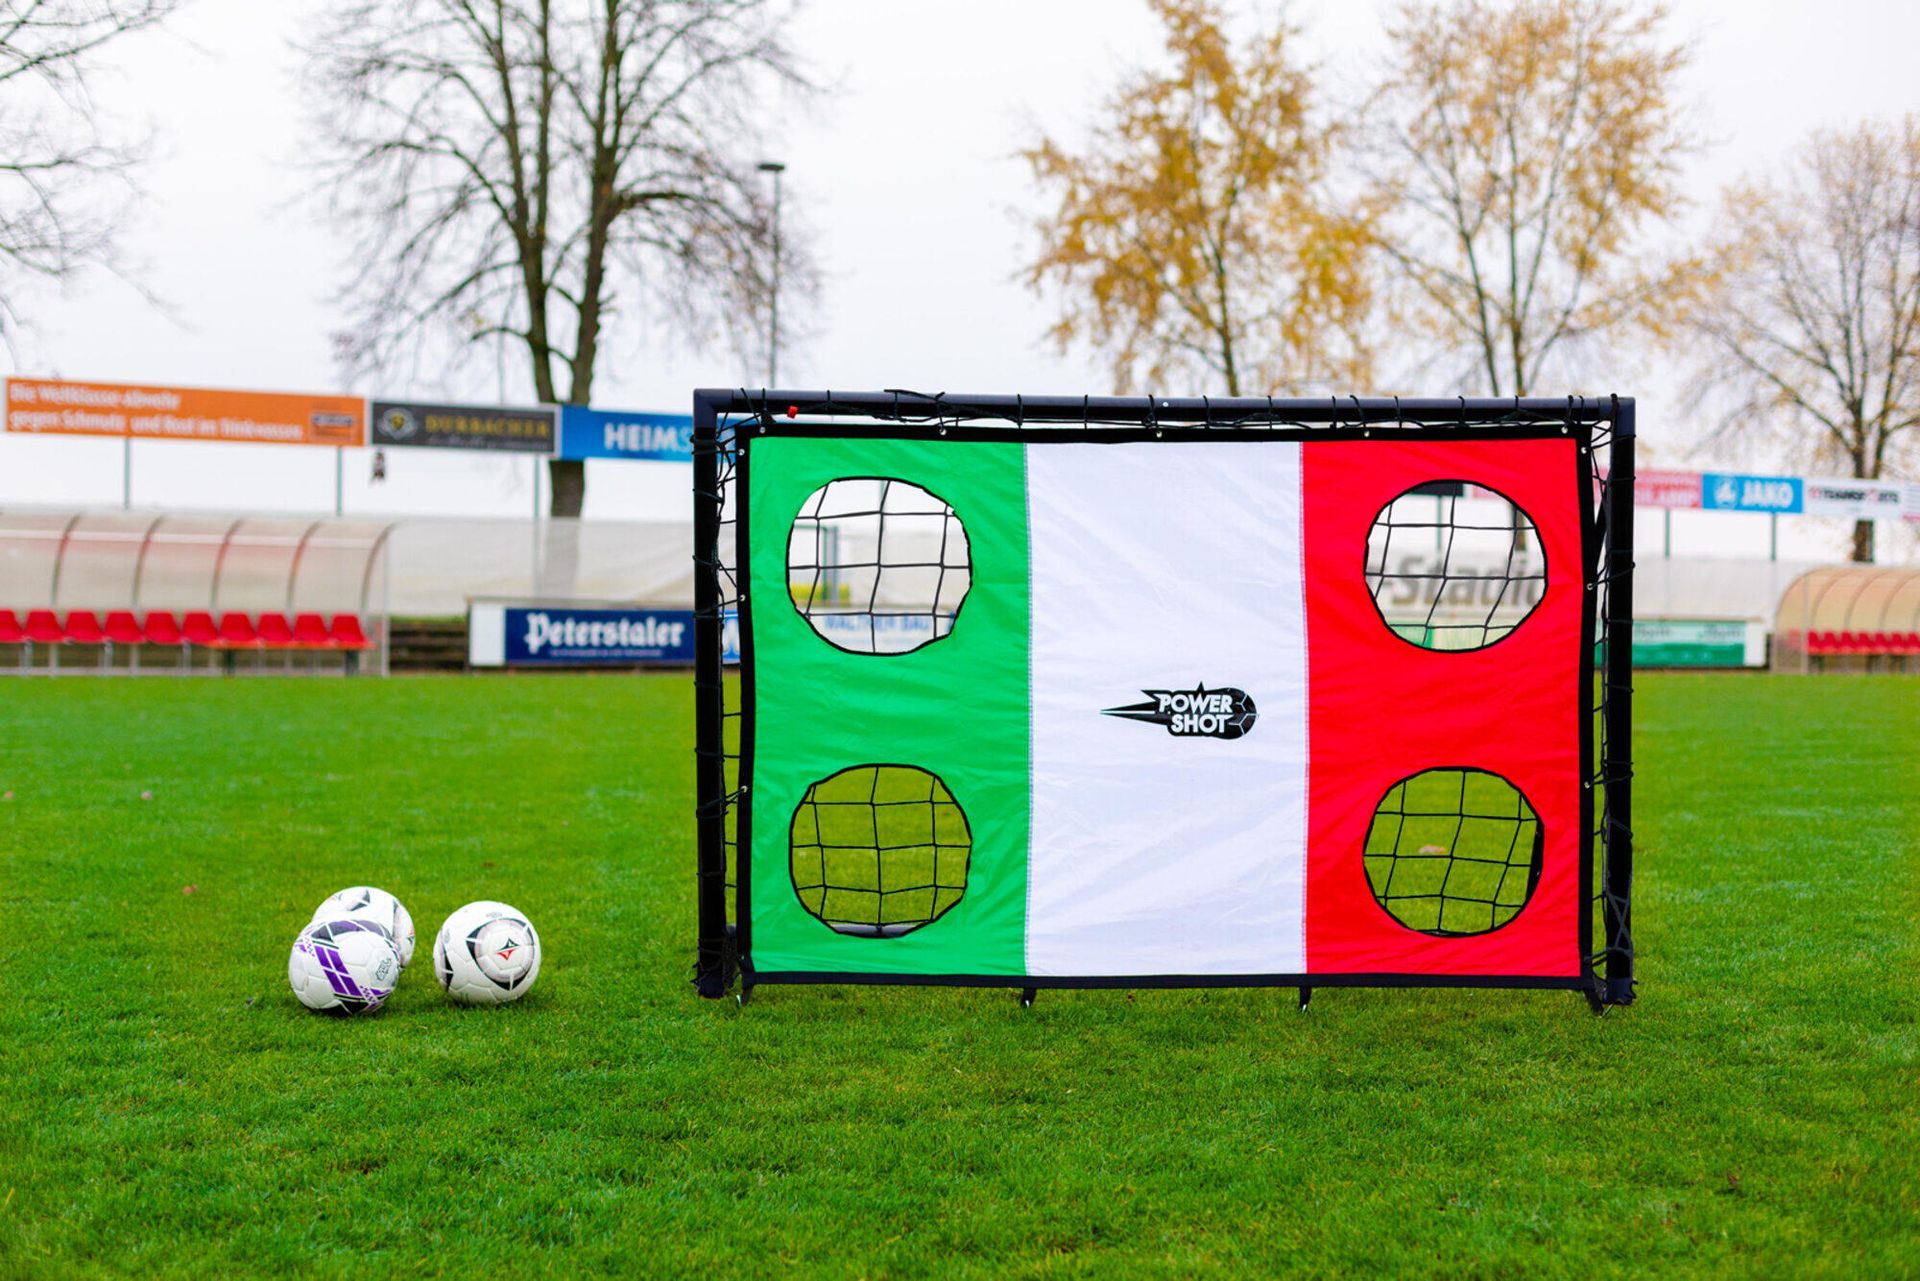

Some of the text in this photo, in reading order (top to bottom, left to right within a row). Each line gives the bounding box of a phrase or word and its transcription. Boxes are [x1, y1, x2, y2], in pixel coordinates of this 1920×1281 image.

[425, 415, 551, 439] DURBACHER
[1741, 479, 1793, 509] JAKO
[523, 612, 685, 655] Peterstaler
[1153, 692, 1234, 714] POWER
[1170, 713, 1234, 734] SHOT
